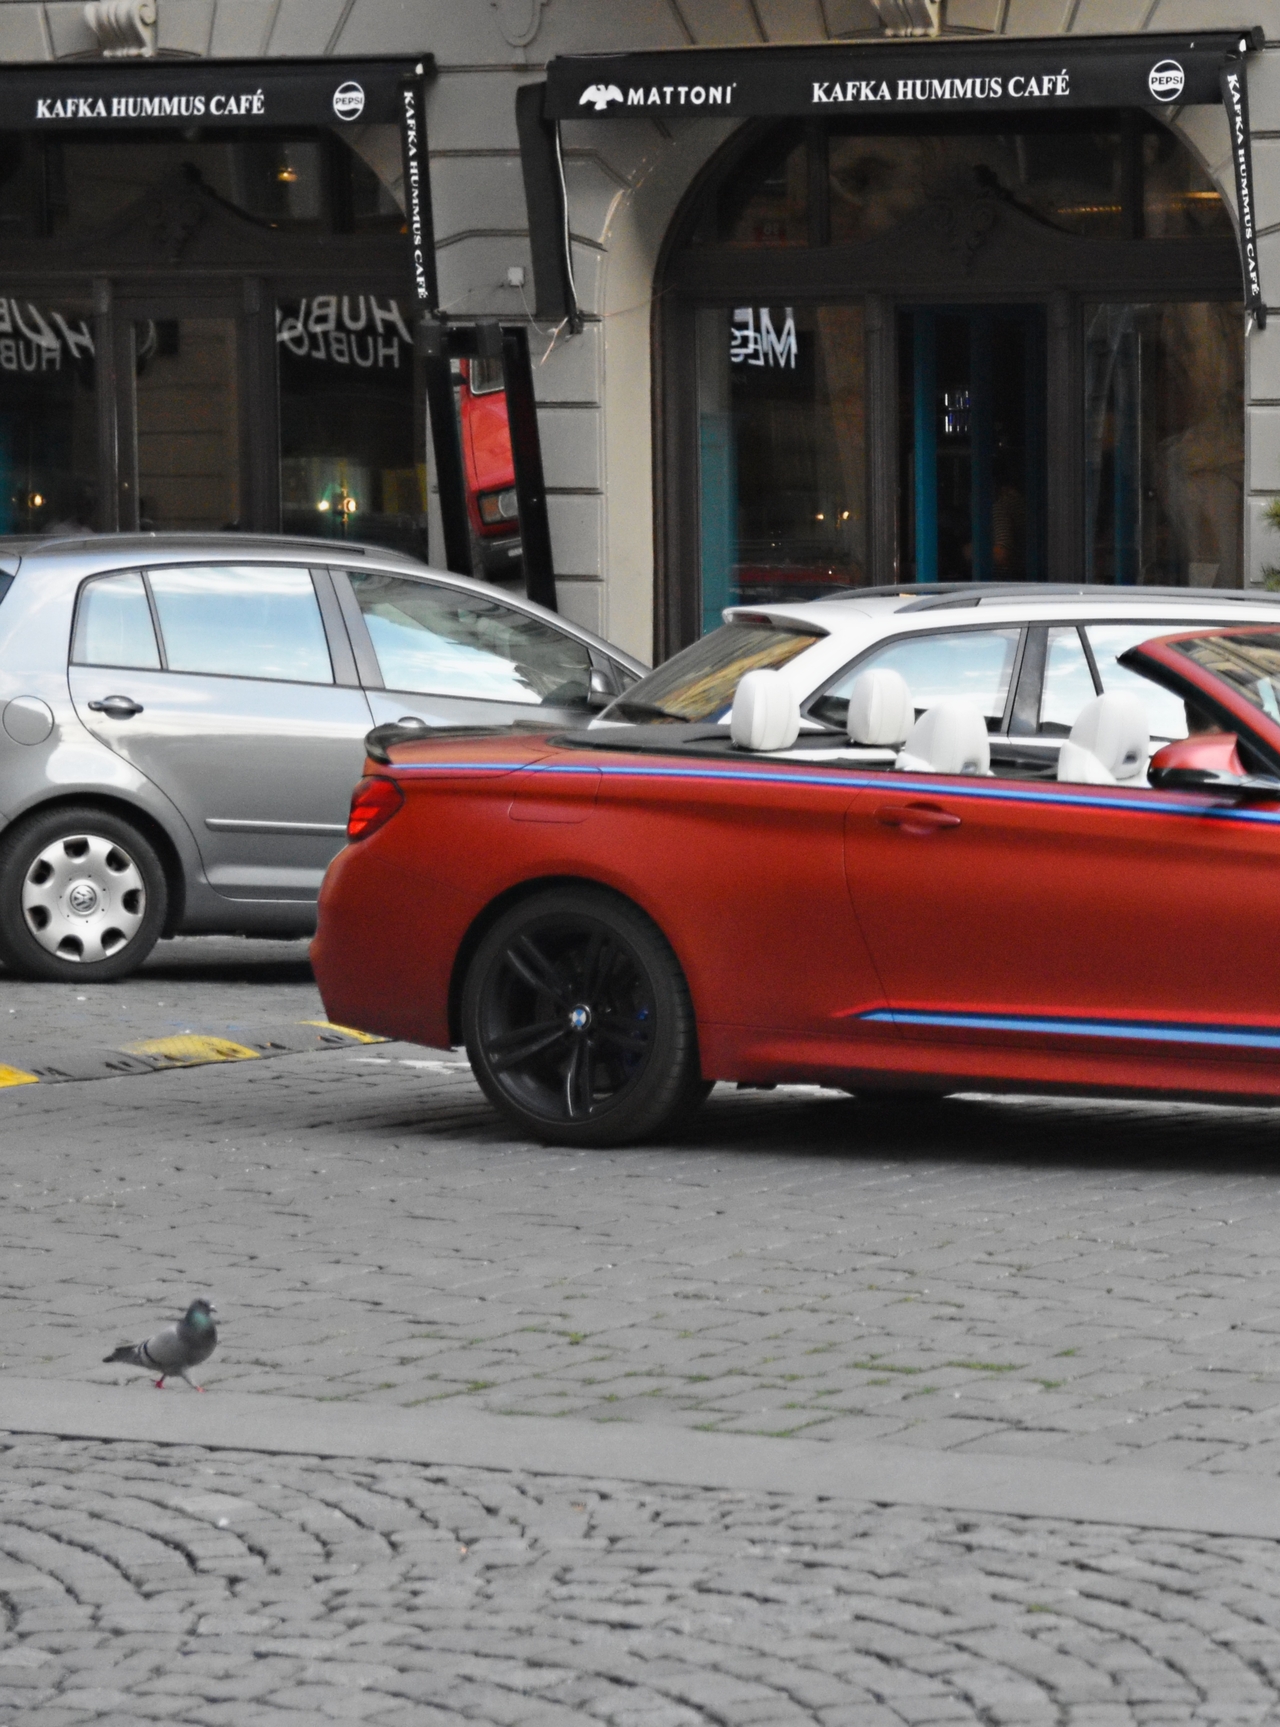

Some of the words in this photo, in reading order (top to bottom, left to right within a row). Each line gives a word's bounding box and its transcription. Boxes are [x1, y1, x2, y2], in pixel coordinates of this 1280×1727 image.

[627, 86, 732, 106] MATTONI
[812, 80, 892, 102] KAFKA
[896, 77, 1002, 100] HUMMUS
[1008, 69, 1070, 97] CAFÉ
[1151, 76, 1183, 85] PEPSI
[36, 98, 107, 118] KAFKA
[111, 96, 205, 117] HUMMUS
[210, 89, 264, 115] CAFÉ
[335, 97, 363, 105] PEPSI
[404, 91, 418, 156] KAFKA
[1227, 74, 1244, 144] KAFKA
[1238, 149, 1253, 239] HUMMUS
[1247, 242, 1260, 296] CAFÉ
[409, 161, 422, 246] HUMMUS
[414, 250, 429, 299] CAFÉ
